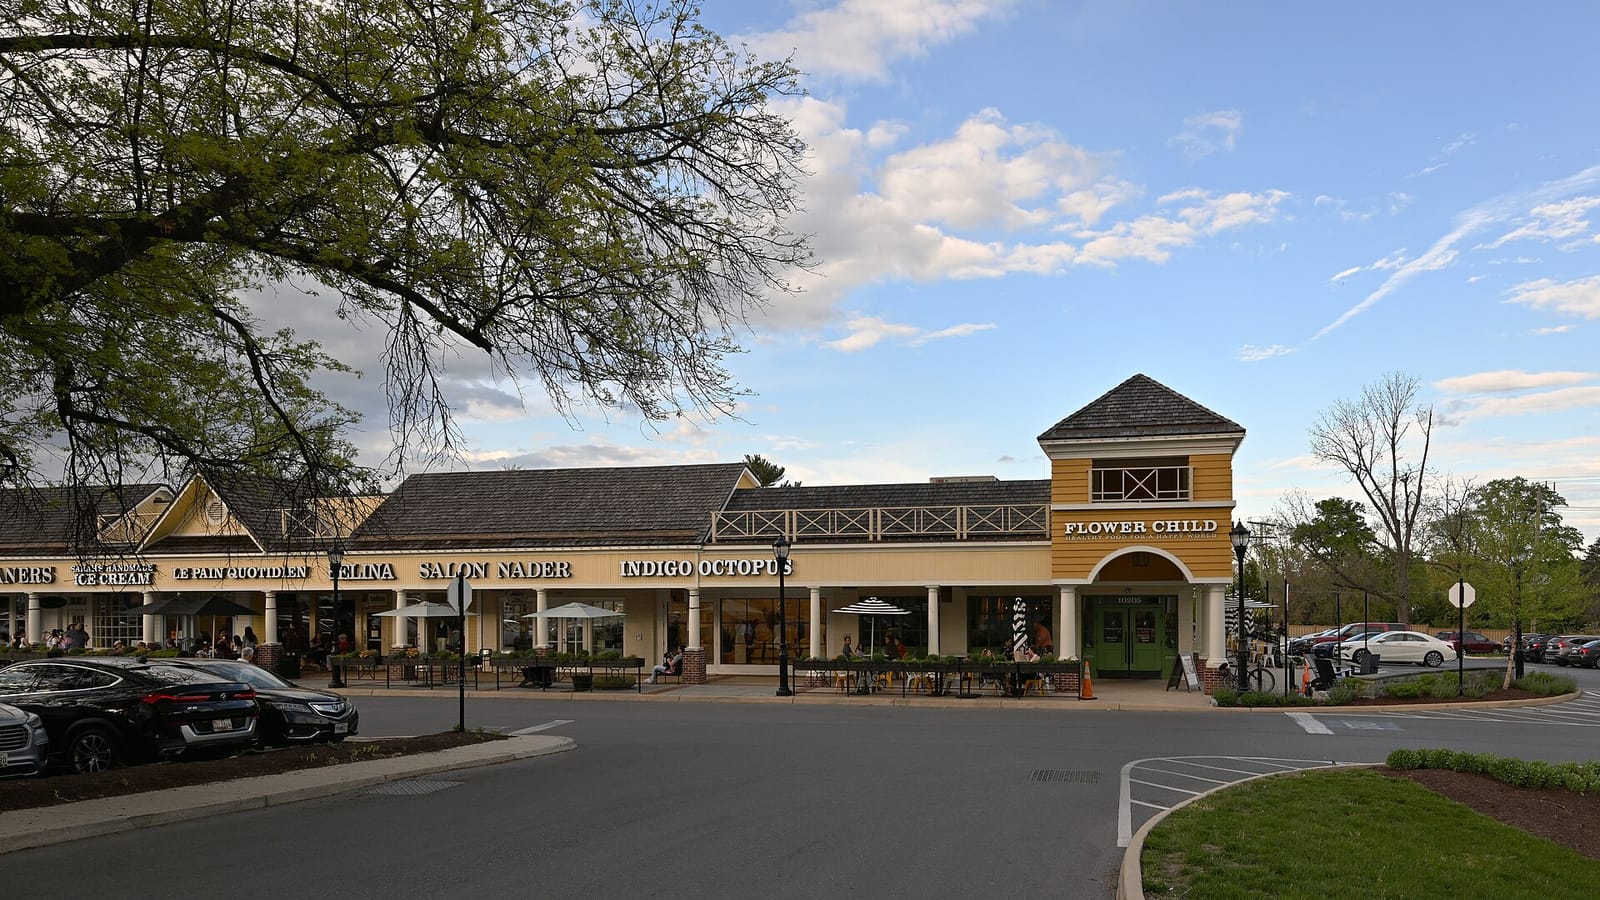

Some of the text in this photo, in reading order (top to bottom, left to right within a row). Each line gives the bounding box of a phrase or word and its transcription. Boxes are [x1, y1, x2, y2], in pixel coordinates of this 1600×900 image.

[1064, 520, 1218, 534] FLOWER CHILD
[172, 566, 308, 579] LE PAIN QUOTIDIEN
[329, 563, 396, 580] ELINA
[419, 561, 572, 579] SALON NADER
[619, 559, 793, 576] INDIGO OCTOPUS
[73, 572, 153, 585] ICE CREAM
